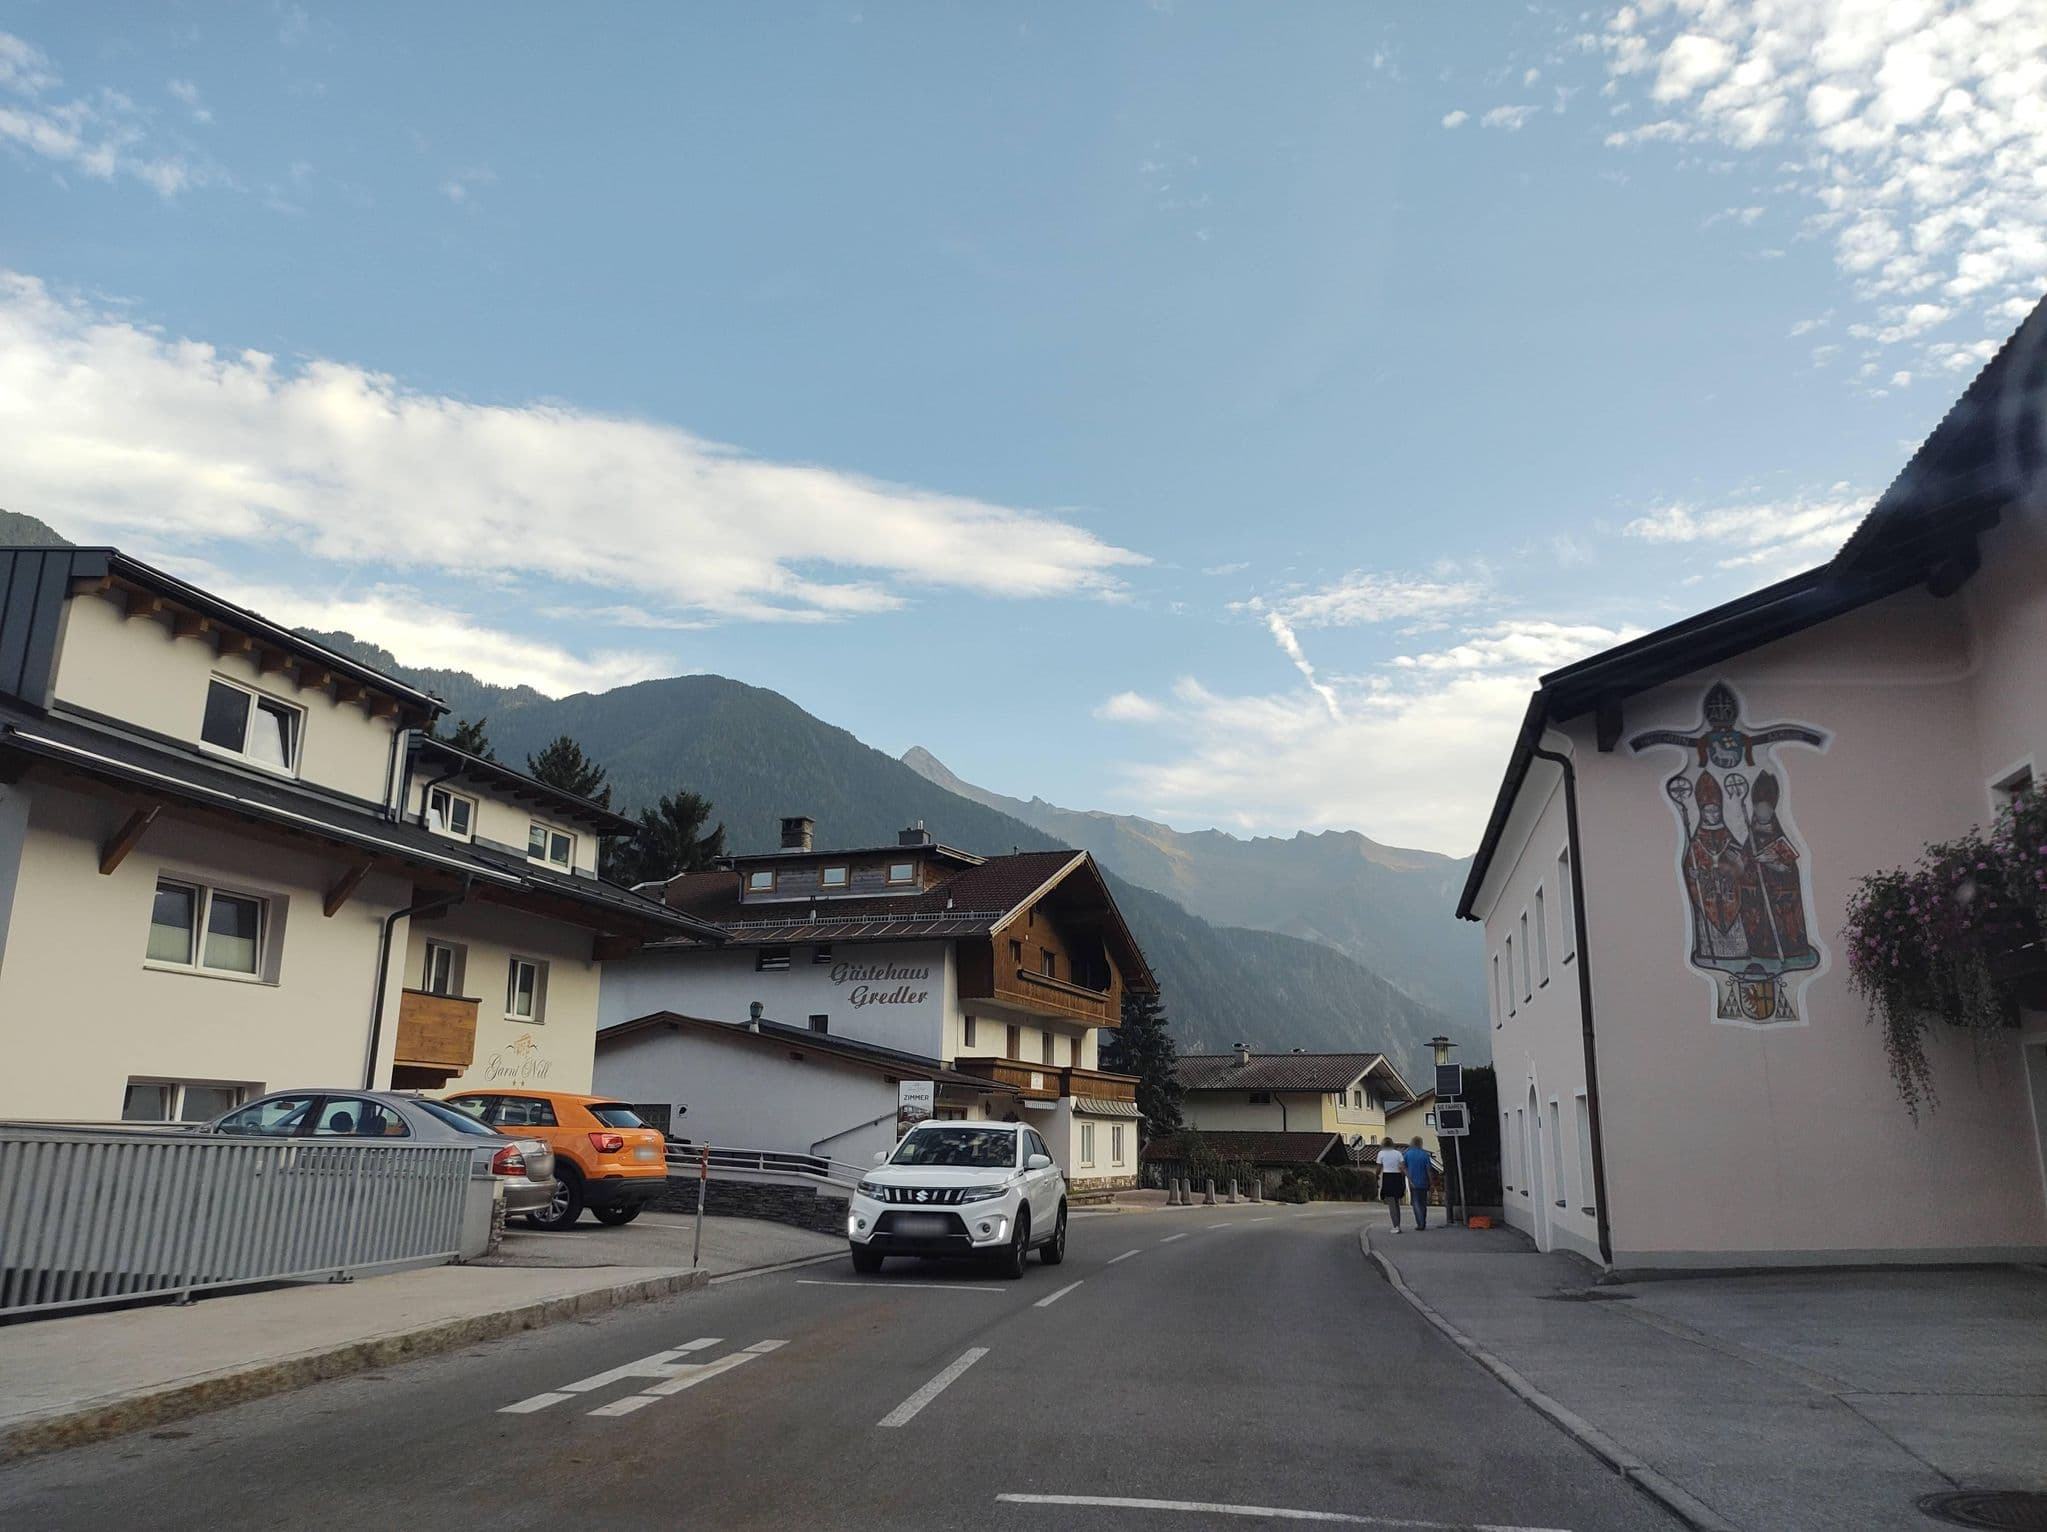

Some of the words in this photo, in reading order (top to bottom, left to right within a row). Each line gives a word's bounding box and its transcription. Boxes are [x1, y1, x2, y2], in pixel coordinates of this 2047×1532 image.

[830, 962, 929, 985] Gästehaus
[848, 985, 928, 1009] Gredler
[485, 1054, 519, 1081] Garni
